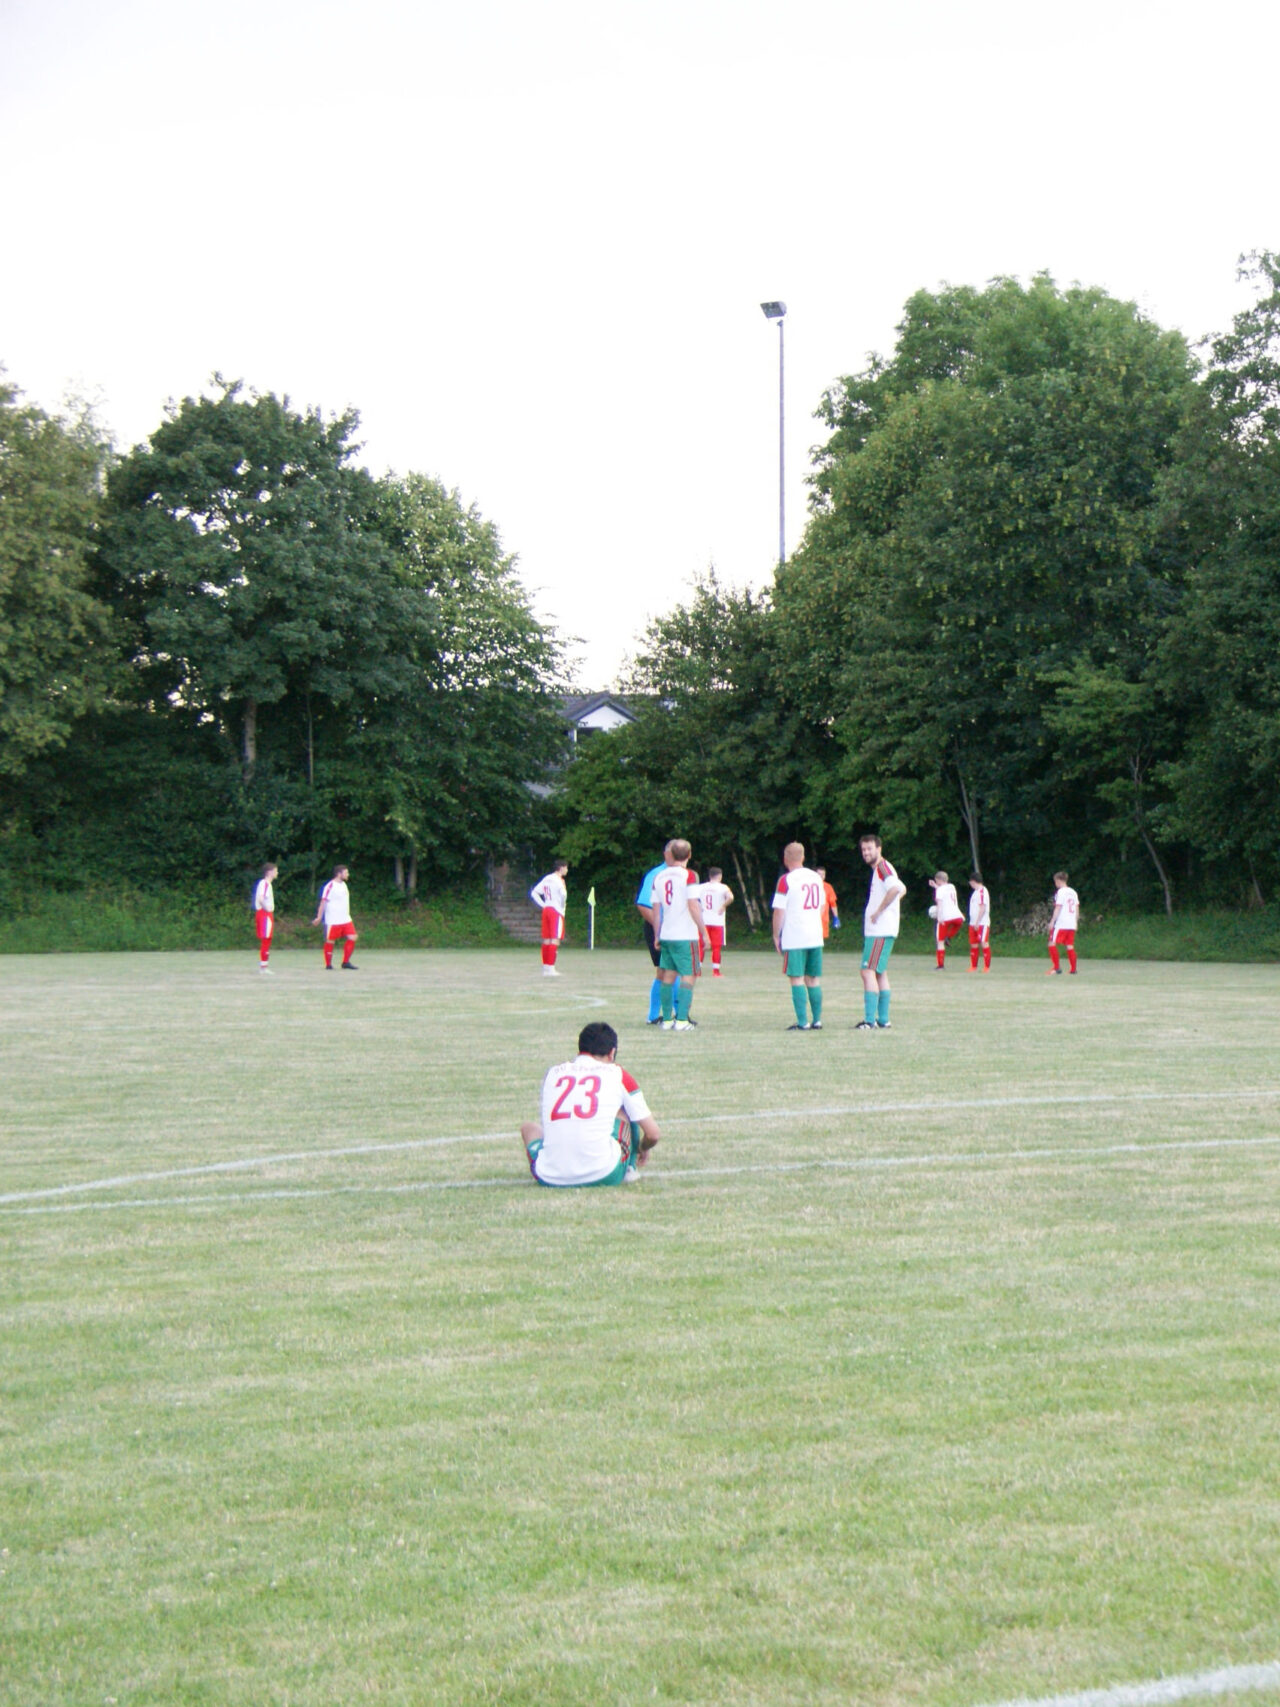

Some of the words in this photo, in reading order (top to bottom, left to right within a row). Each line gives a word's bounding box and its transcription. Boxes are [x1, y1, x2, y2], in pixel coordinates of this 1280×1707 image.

[664, 879, 673, 906] 8
[705, 894, 713, 910] 9
[801, 883, 820, 910] 20
[550, 1074, 602, 1121] 23
